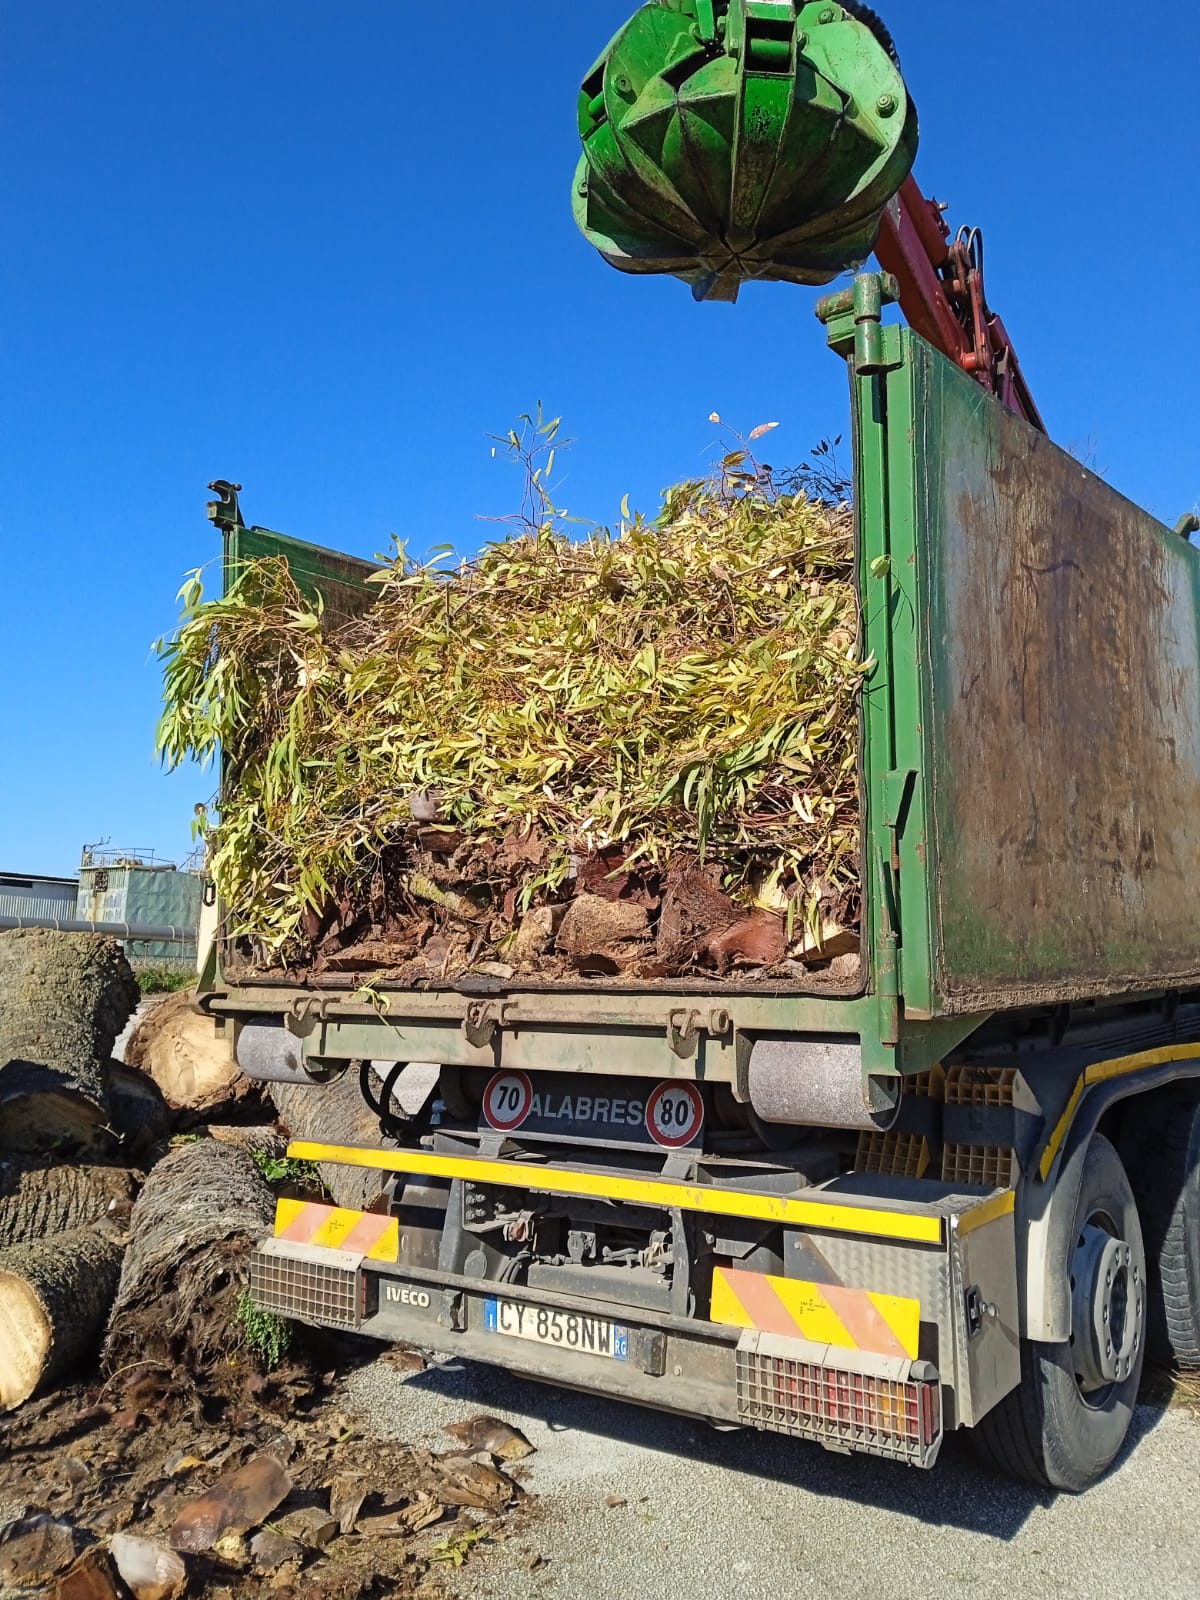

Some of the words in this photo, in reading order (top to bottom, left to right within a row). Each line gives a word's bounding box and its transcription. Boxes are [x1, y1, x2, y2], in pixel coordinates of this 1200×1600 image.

[497, 1085, 520, 1111] 70
[528, 1093, 646, 1126] ALABRES
[660, 1098, 689, 1127] 80
[386, 1286, 431, 1309] IVECO
[500, 1300, 526, 1334] CY
[537, 1308, 611, 1354] 858NW
[615, 1340, 627, 1355] RG
